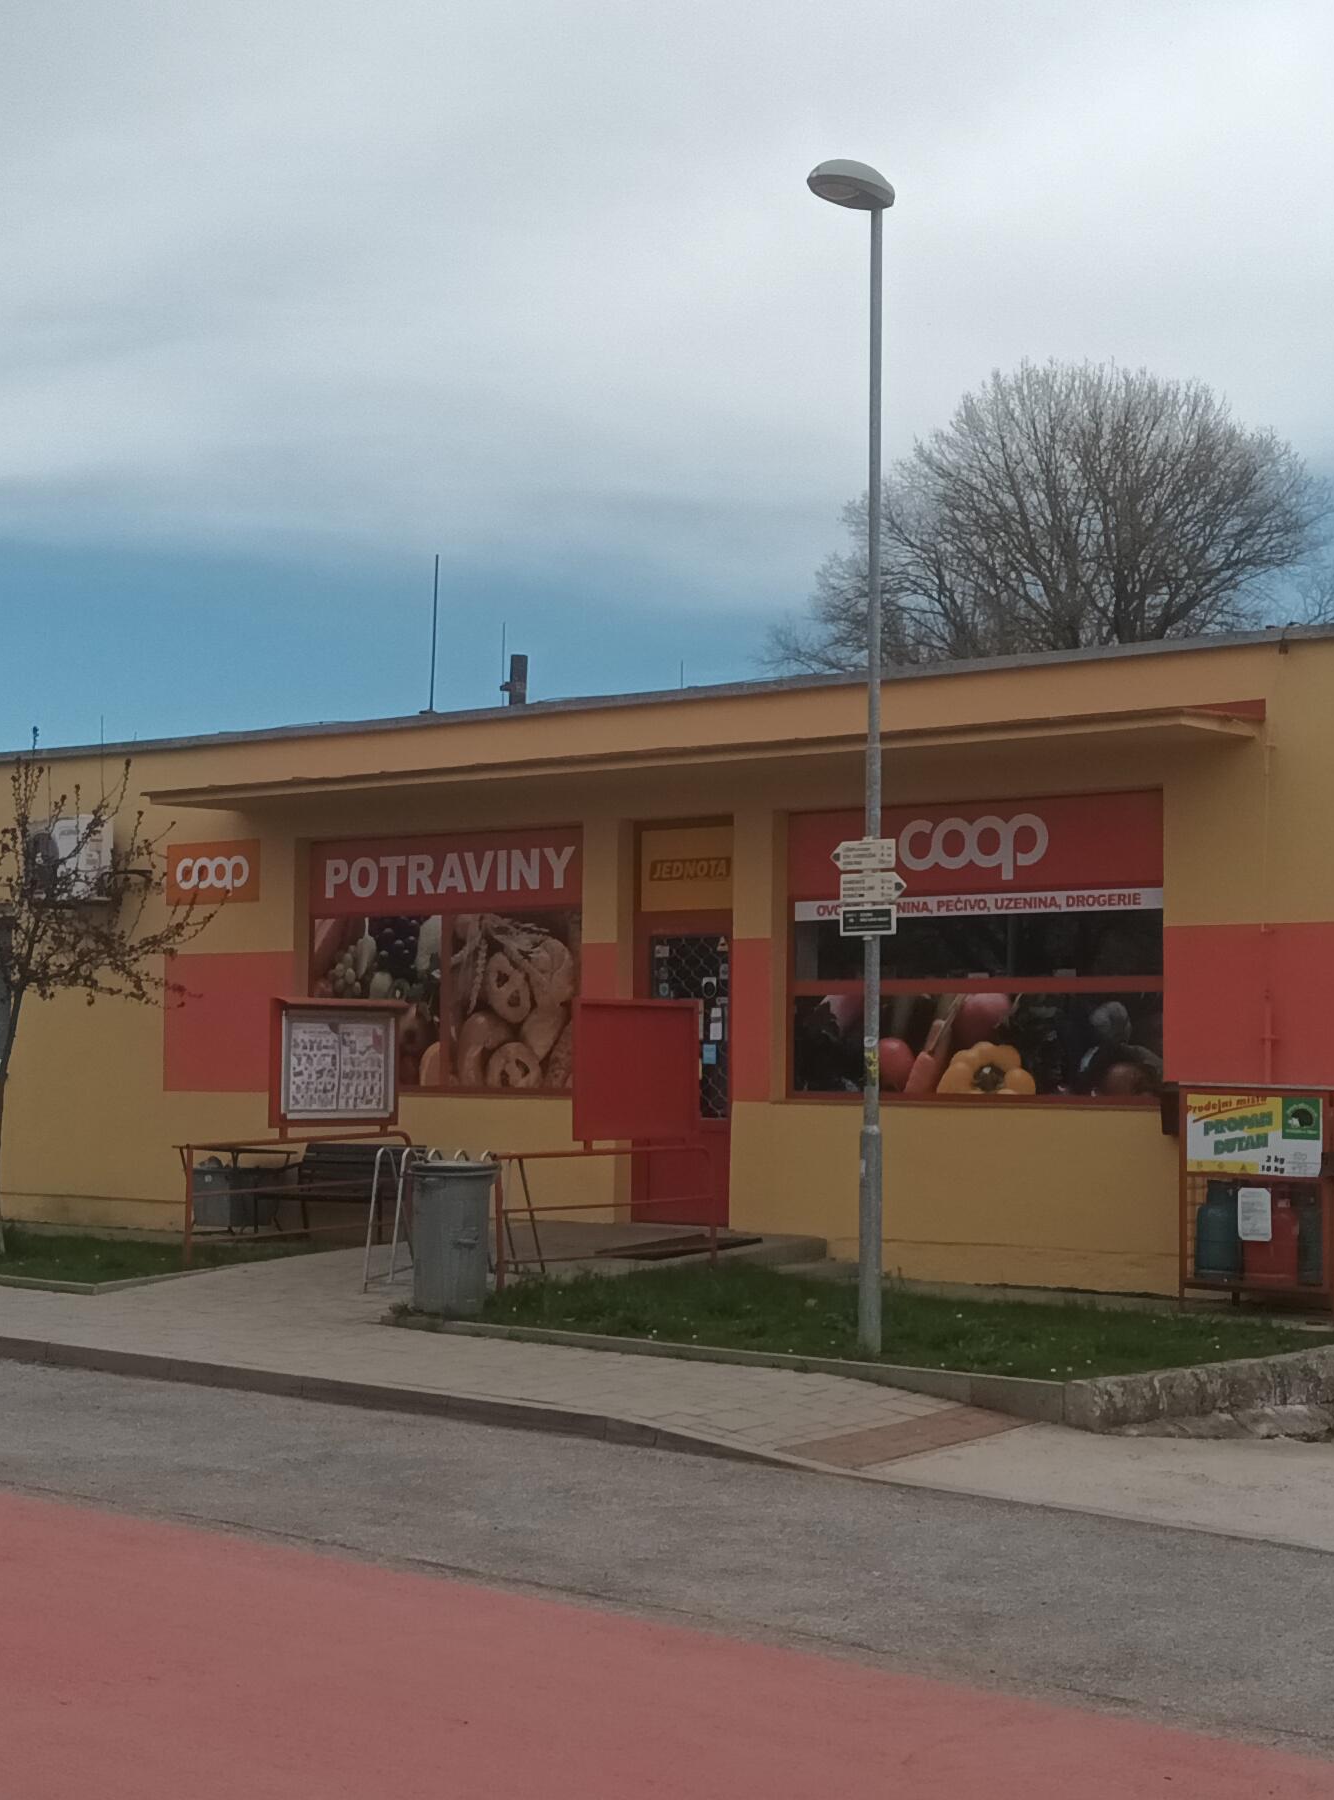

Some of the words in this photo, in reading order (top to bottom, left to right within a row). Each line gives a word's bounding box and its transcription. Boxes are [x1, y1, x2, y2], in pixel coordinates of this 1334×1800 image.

[898, 813, 1048, 880] coop
[176, 855, 249, 896] coop
[325, 846, 576, 899] POTRAVINY
[652, 860, 727, 879] JEDNOTA
[937, 898, 991, 912] PEČIVO,
[995, 896, 1062, 911] UZENINA,
[1066, 892, 1141, 908] DROGERIE
[1203, 1111, 1273, 1136] PROPAN
